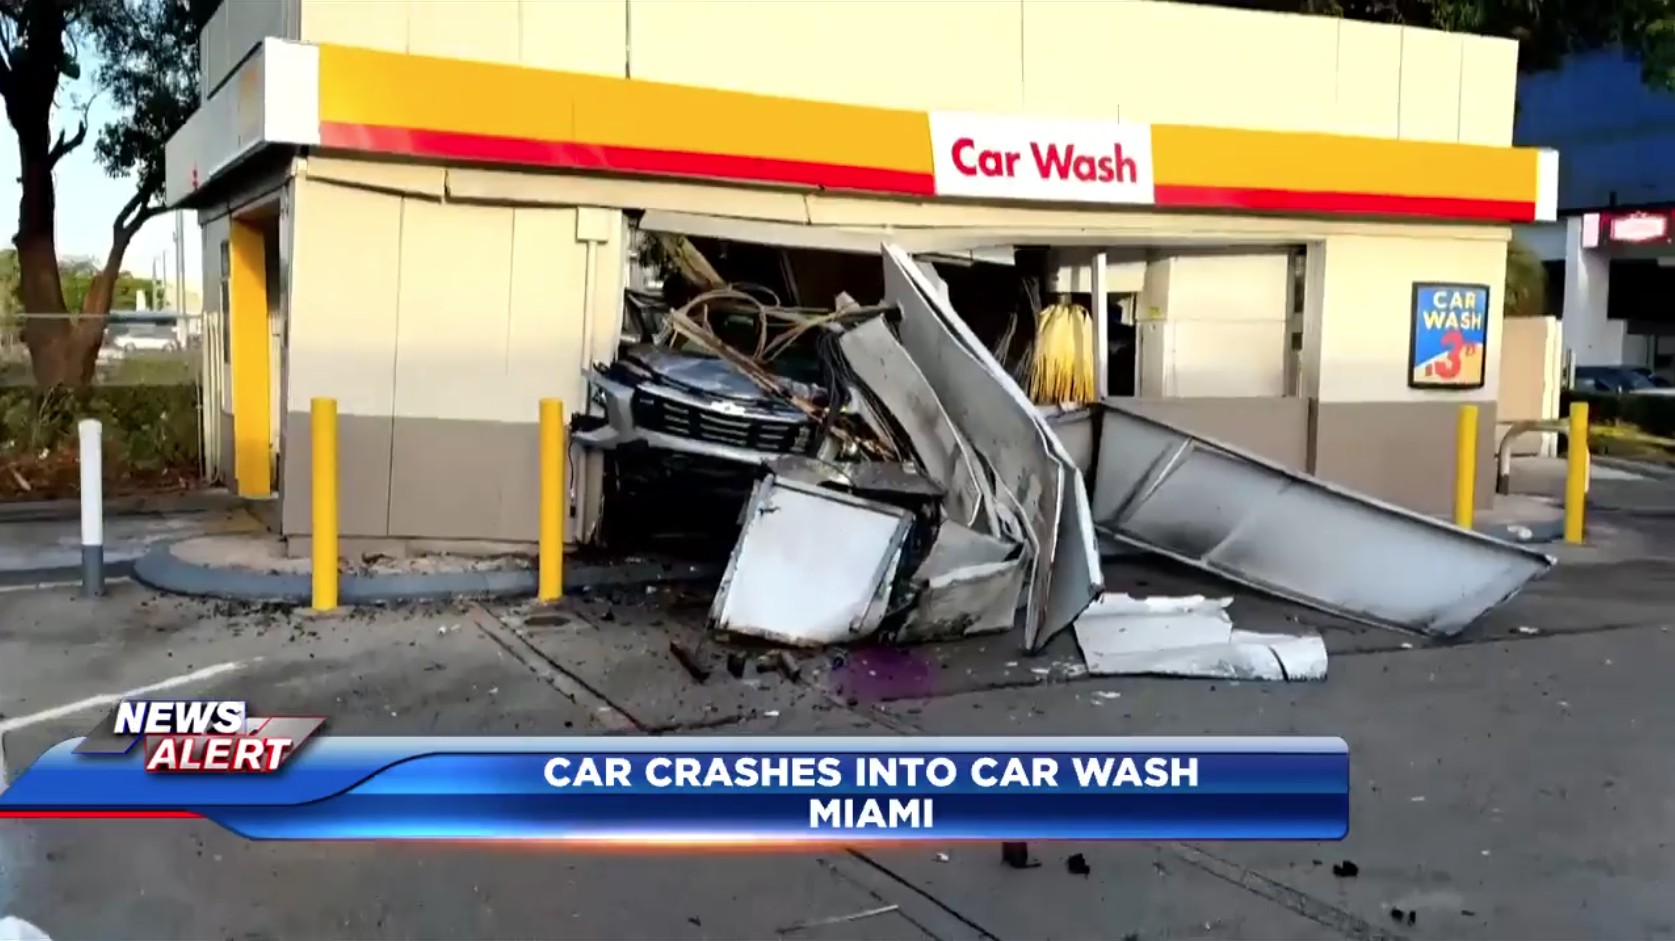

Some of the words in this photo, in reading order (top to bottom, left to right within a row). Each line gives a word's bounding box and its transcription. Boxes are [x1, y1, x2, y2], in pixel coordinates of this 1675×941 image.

[951, 137, 1021, 177] Car
[1030, 142, 1138, 183] Wash
[1433, 291, 1476, 309] CAR
[1423, 310, 1482, 330] WASH
